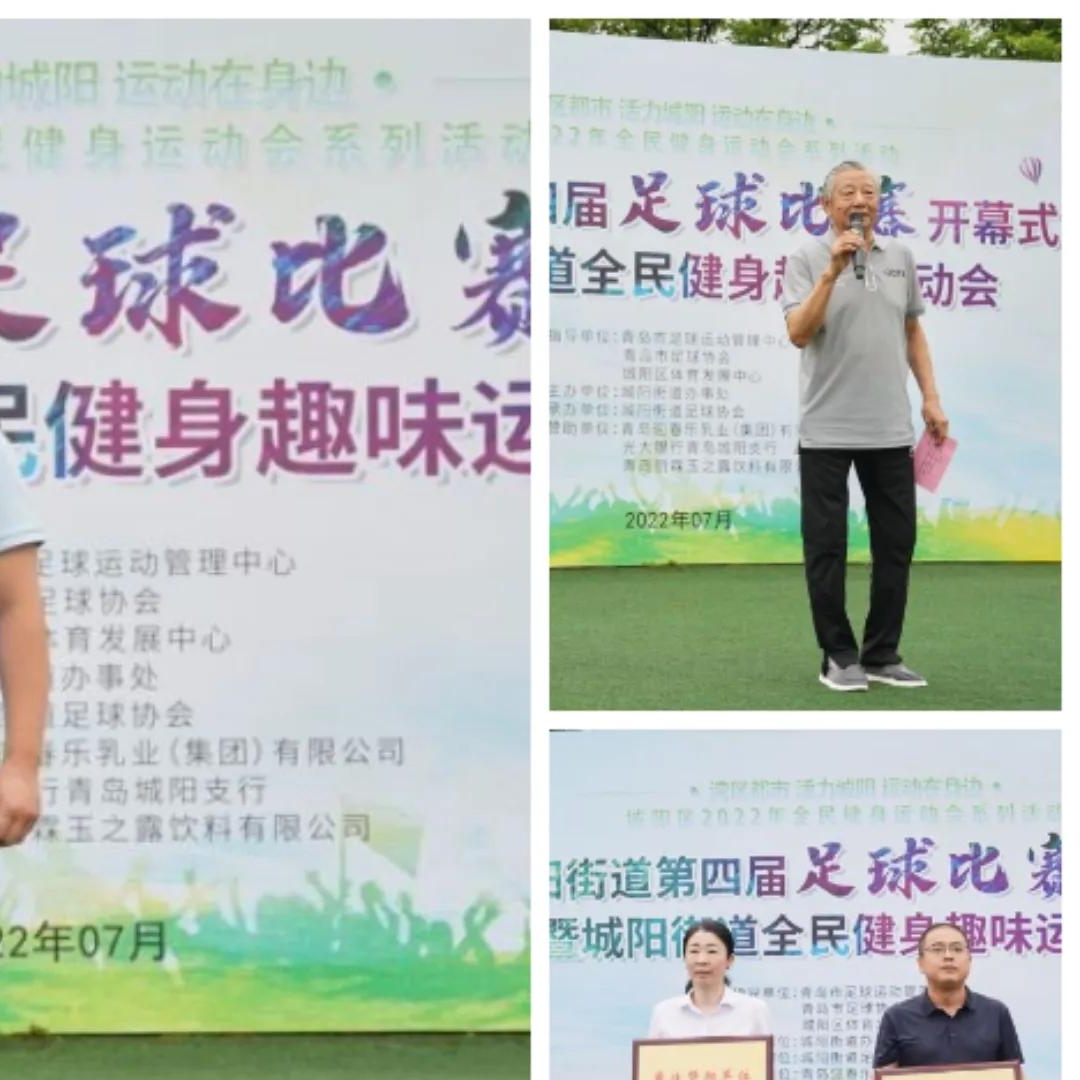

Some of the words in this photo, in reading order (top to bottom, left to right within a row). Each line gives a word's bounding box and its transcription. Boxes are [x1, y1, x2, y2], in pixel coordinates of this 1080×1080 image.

[115, 58, 352, 108] 运动在身边
[620, 170, 917, 238] 足球比赛
[927, 197, 1059, 247] 开幕式
[626, 510, 734, 530] 2022年07月
[797, 832, 1062, 900] 足球比赛
